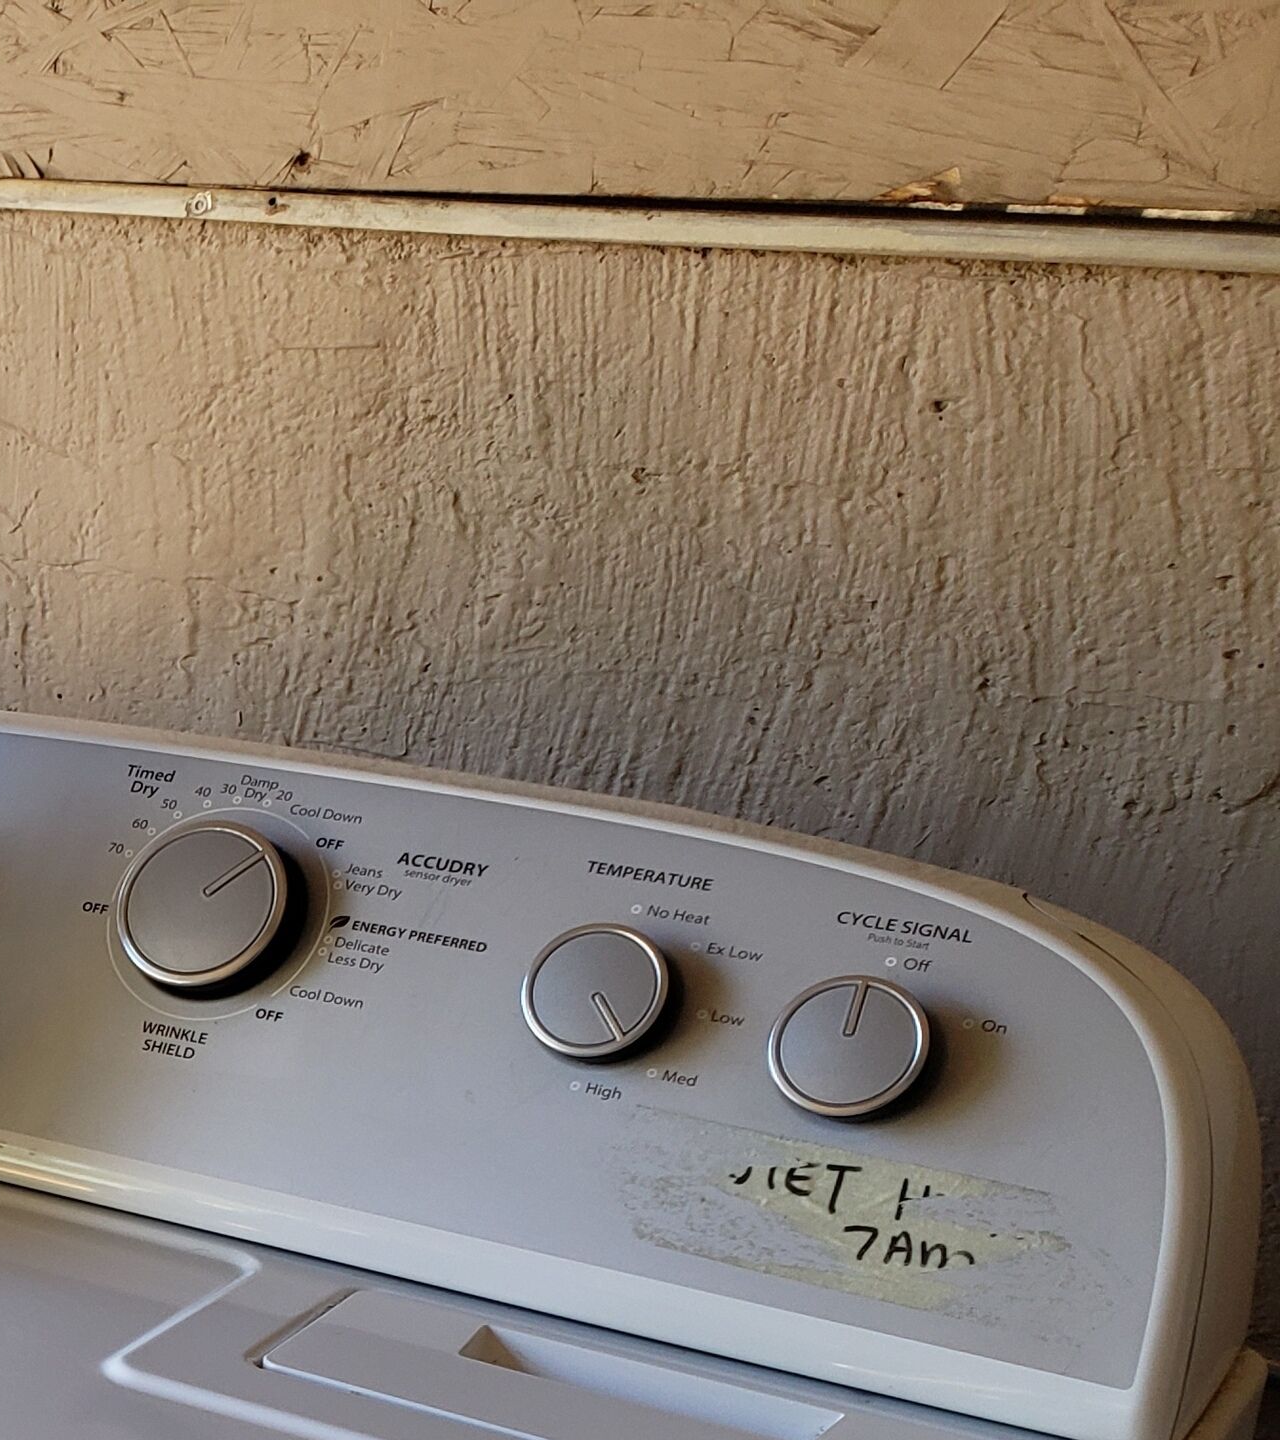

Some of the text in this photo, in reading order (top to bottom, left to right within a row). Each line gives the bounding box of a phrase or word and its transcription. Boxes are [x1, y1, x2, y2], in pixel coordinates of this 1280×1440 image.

[127, 764, 176, 783] Timed
[240, 774, 279, 791] Damp
[130, 781, 160, 798] Dry
[194, 786, 212, 798] 40
[220, 783, 237, 796] 30
[244, 787, 268, 802] Dry
[276, 789, 293, 802] 20
[160, 798, 177, 810] 50
[289, 803, 363, 825] Cool Down
[132, 818, 149, 830] 60
[107, 842, 125, 854] 70
[315, 837, 345, 851] OFF
[344, 863, 384, 879] Jeans
[397, 852, 490, 878] ACCUDRY
[403, 868, 472, 887] sensor dryer
[587, 860, 715, 892] TEMPERATURE
[344, 878, 403, 901] Very Dry
[82, 900, 110, 916] OFF
[646, 904, 711, 926] No Heat
[351, 920, 488, 953] ENERGY PREFERRED
[837, 911, 973, 944] CYCLE SIGNAL
[334, 936, 390, 956] Delicate
[867, 932, 930, 951] Push to Start
[706, 942, 764, 962] Ex Low
[327, 952, 385, 974] Less Dry
[903, 957, 933, 972] Off
[289, 985, 364, 1009] Cool Down
[255, 1008, 284, 1023] OFF
[710, 1009, 745, 1027] Low
[141, 1020, 209, 1045] WRINKLE
[981, 1018, 1008, 1035] On
[141, 1038, 196, 1060] SHIELD
[661, 1069, 698, 1087] Med
[585, 1082, 622, 1101] High
